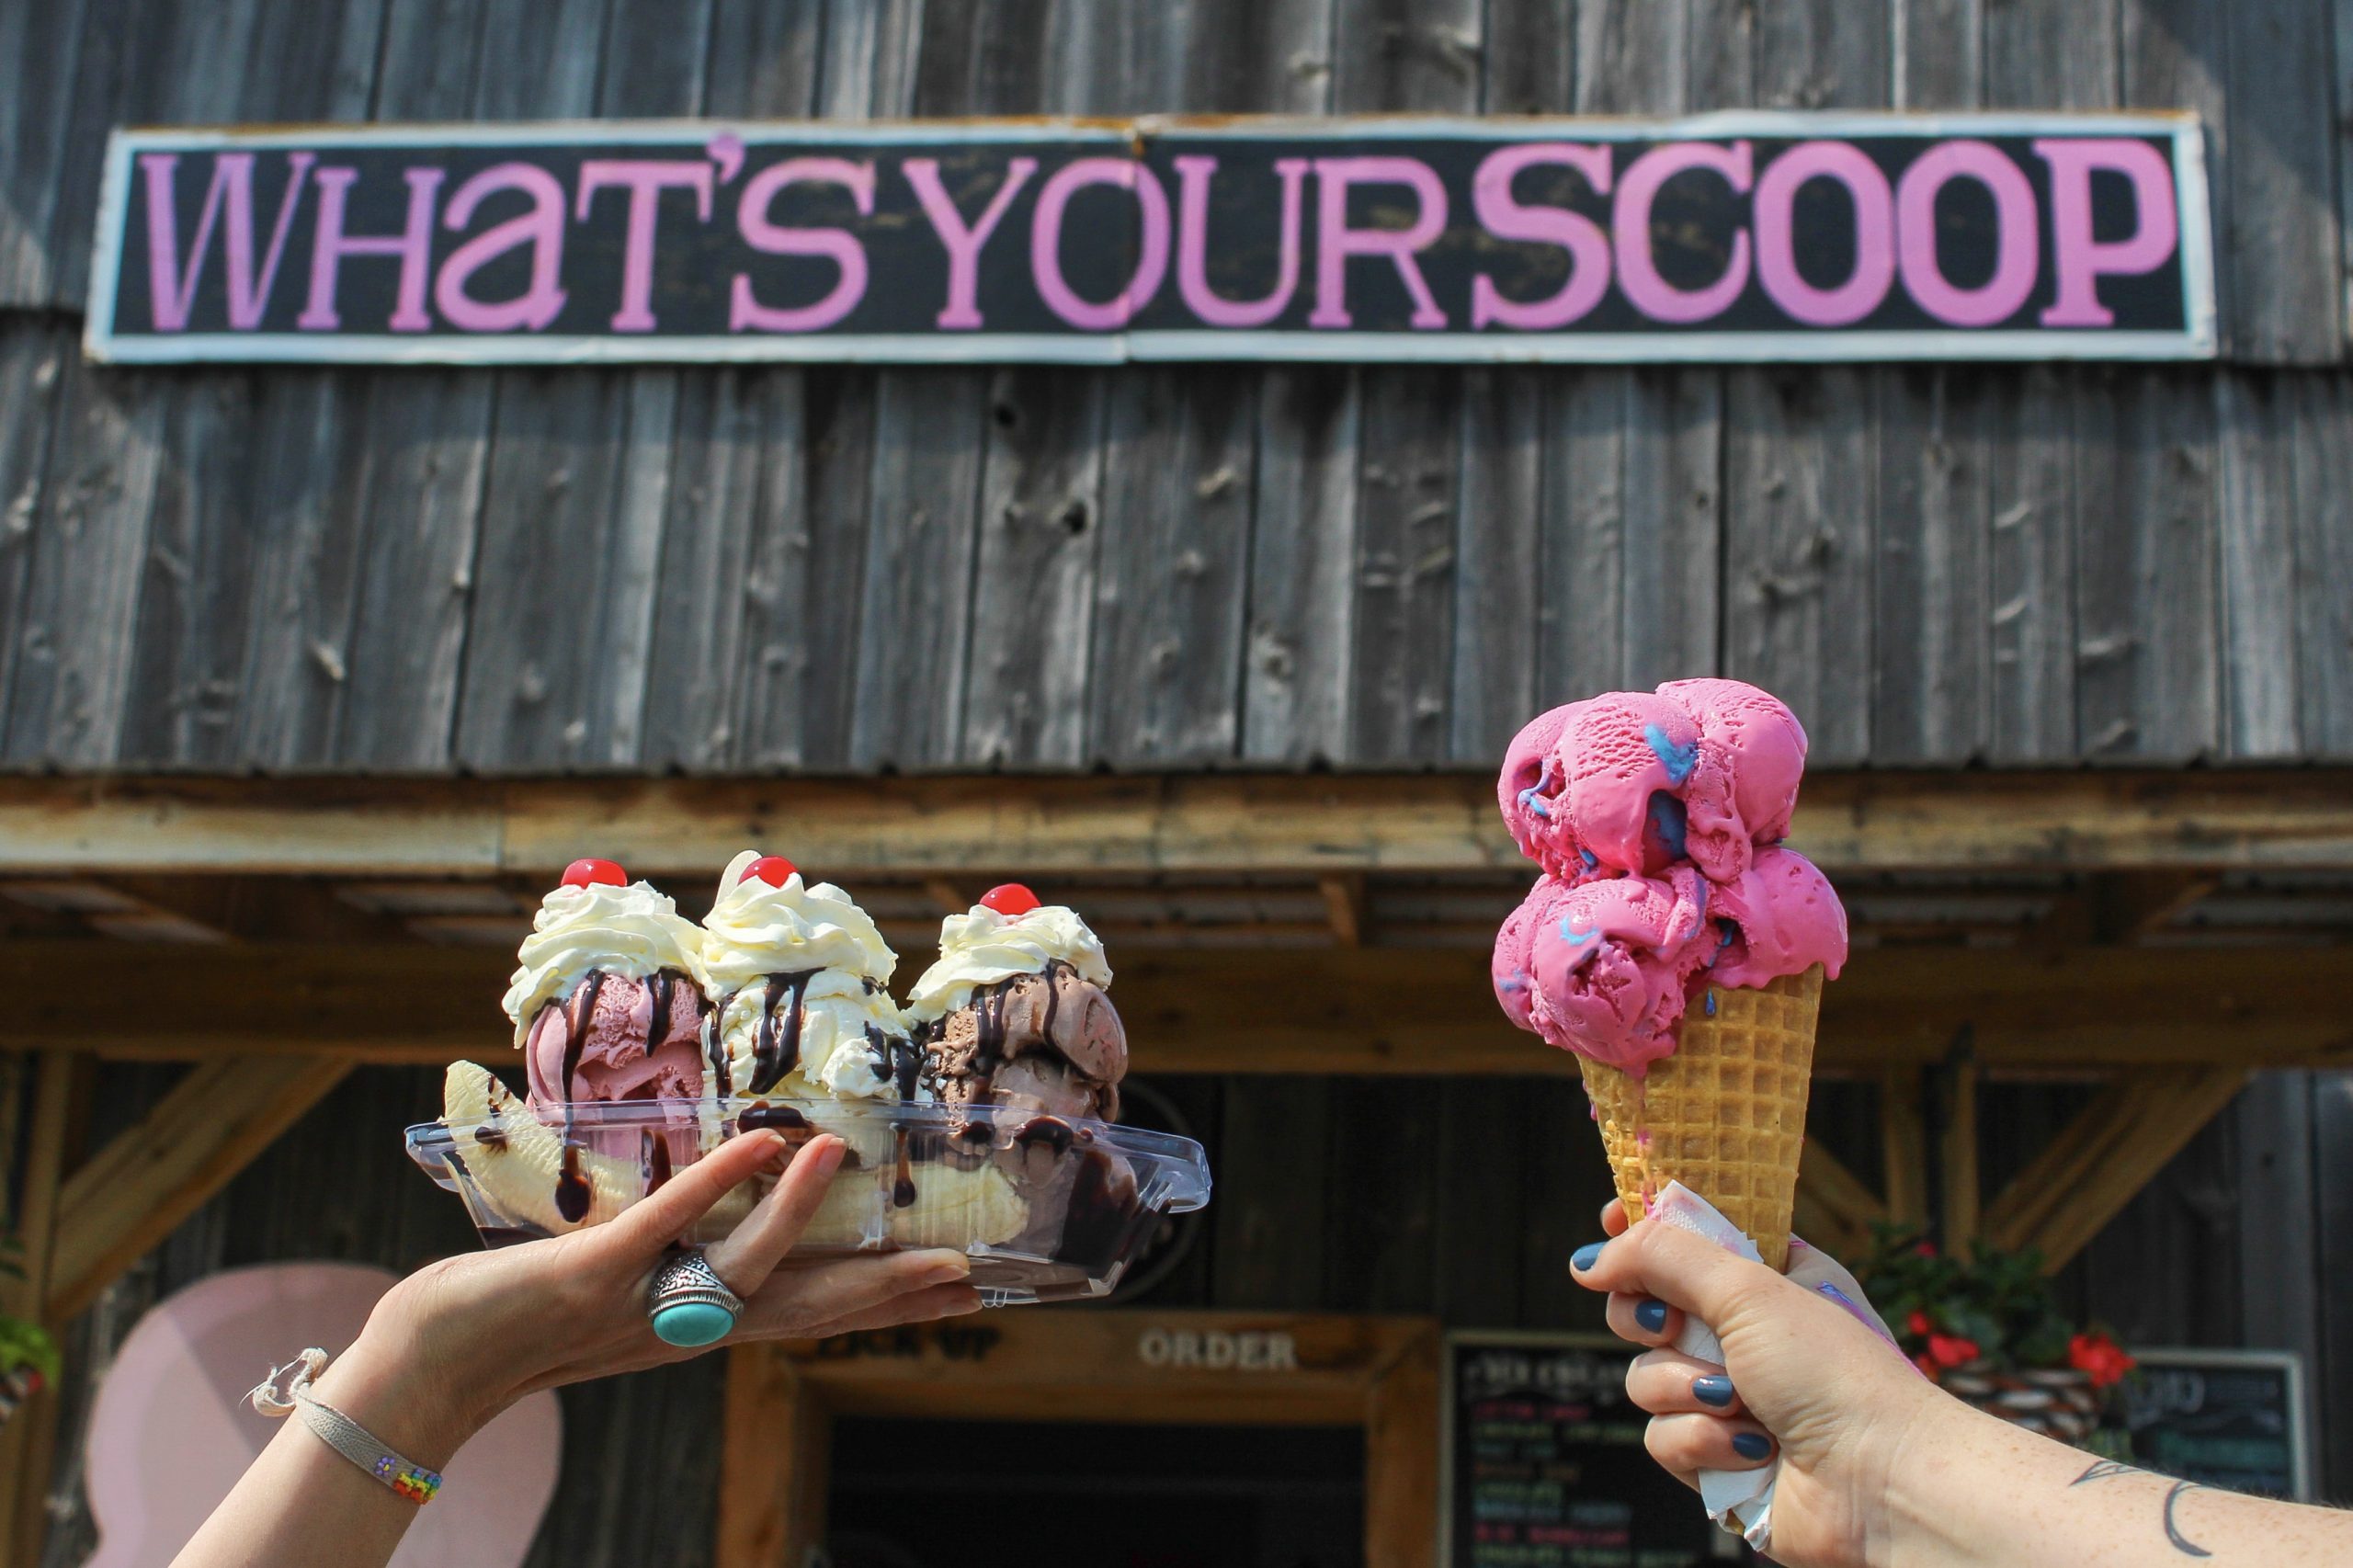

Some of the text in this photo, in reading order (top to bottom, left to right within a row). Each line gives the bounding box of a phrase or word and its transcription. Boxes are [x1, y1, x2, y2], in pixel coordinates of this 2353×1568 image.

[903, 154, 1449, 331] YOUR
[1472, 139, 2178, 331] SCOOP
[936, 1324, 1001, 1361] UP
[1138, 1329, 1299, 1370] ORDER
